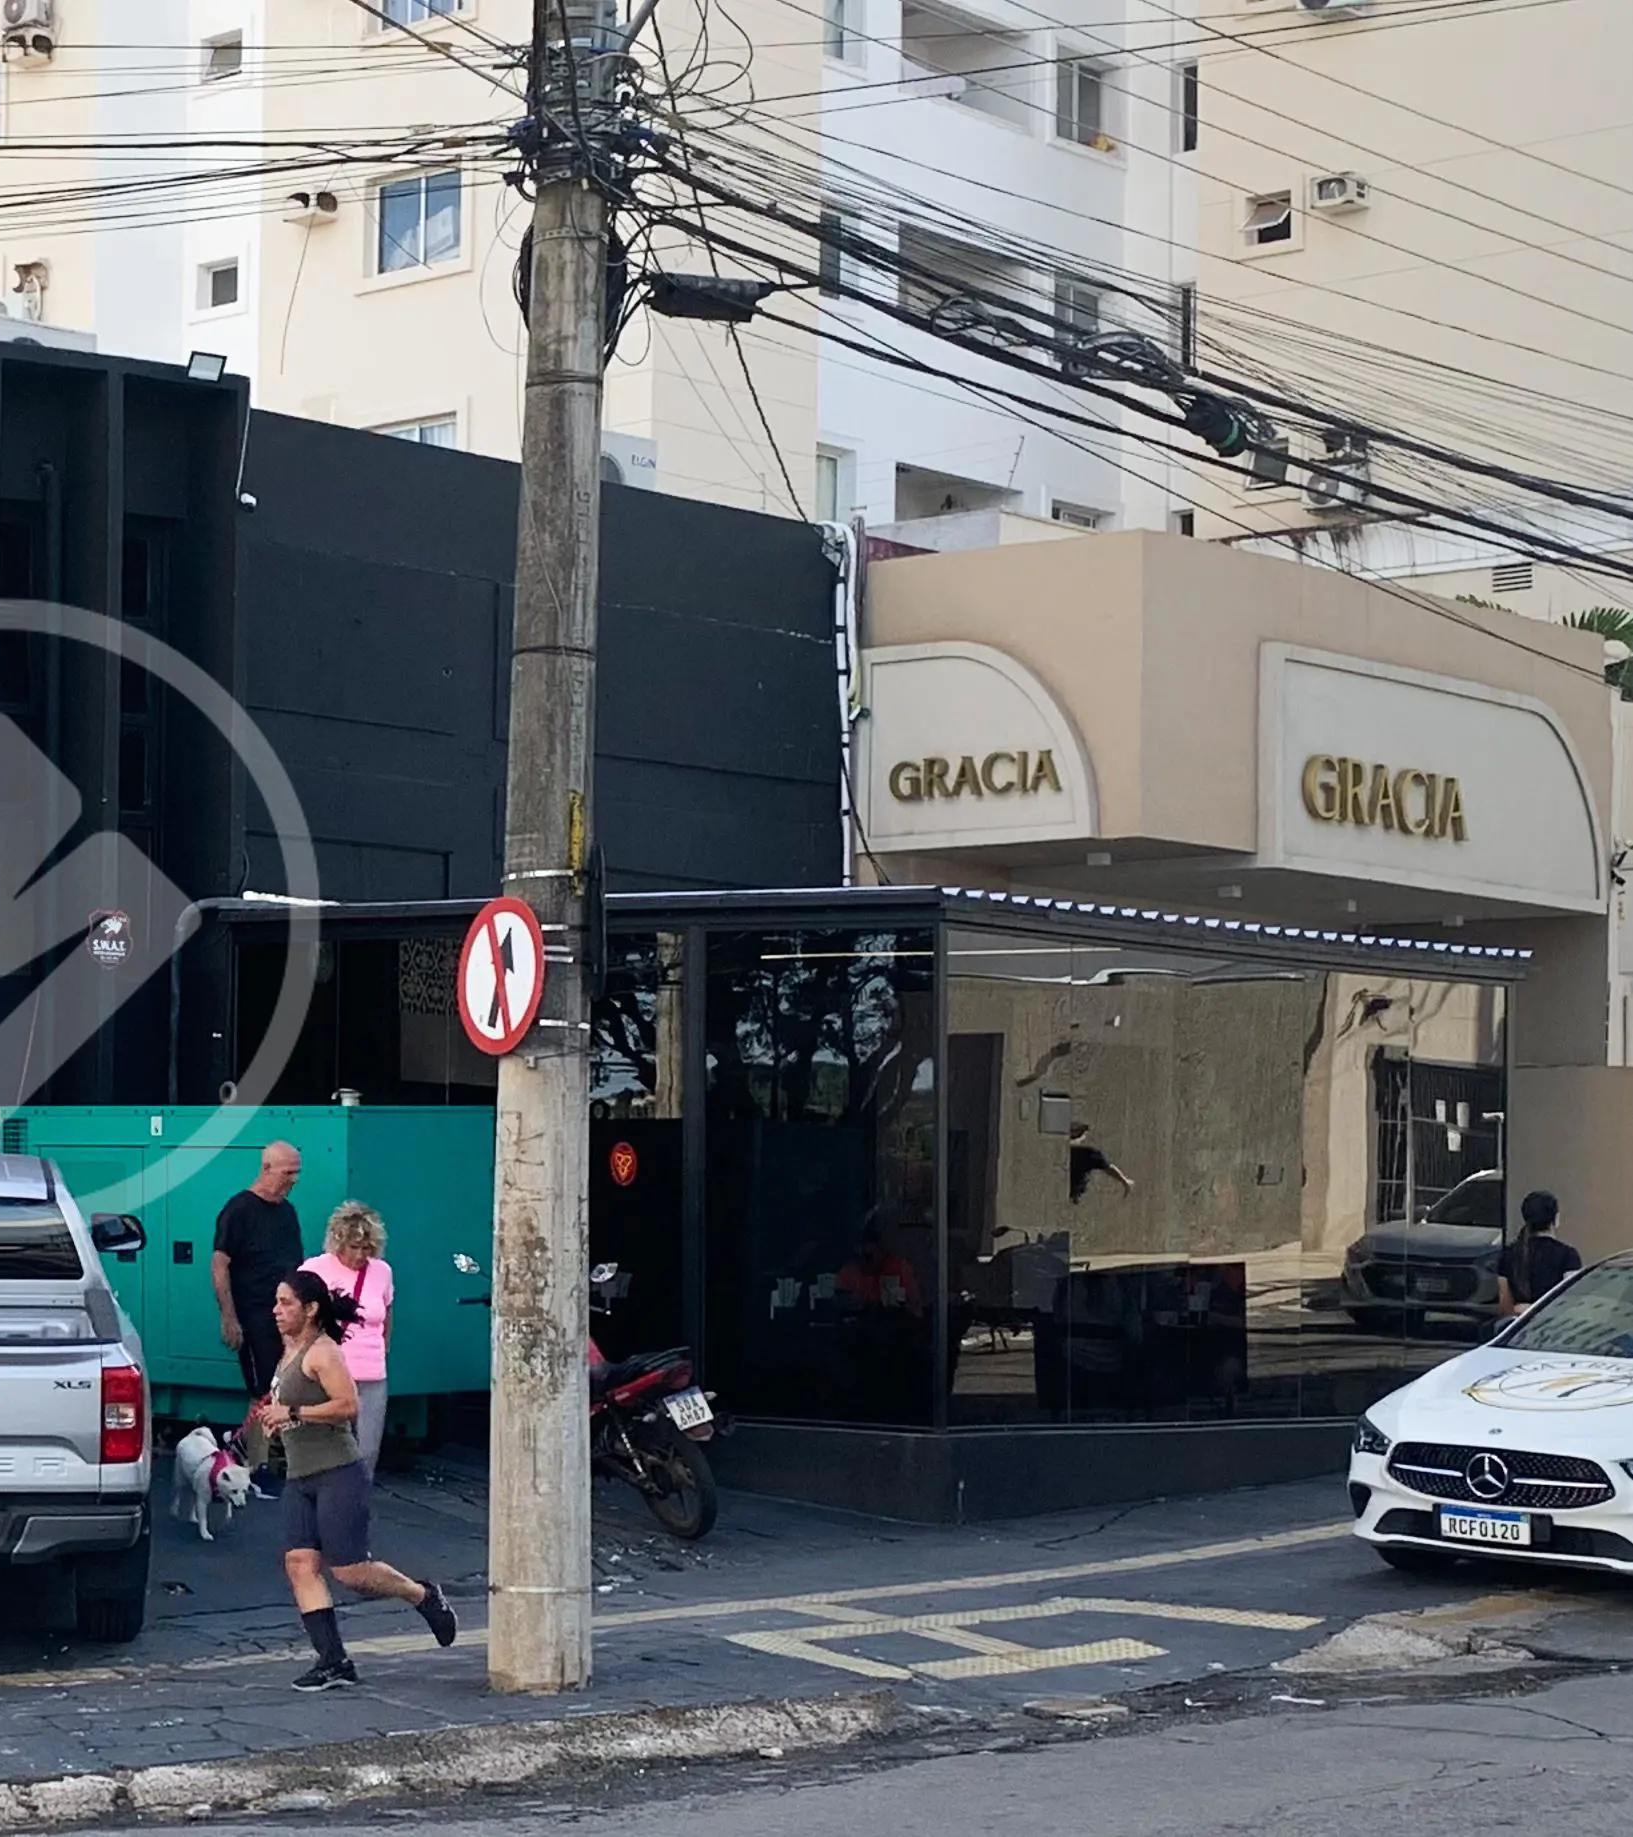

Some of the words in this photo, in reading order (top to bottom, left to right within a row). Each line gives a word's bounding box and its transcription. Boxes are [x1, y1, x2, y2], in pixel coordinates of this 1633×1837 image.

[888, 748, 1062, 804] GRACIA
[1301, 753, 1469, 842] GRACIA
[52, 1380, 92, 1390] XLS
[1448, 1517, 1521, 1541] RCF0120
